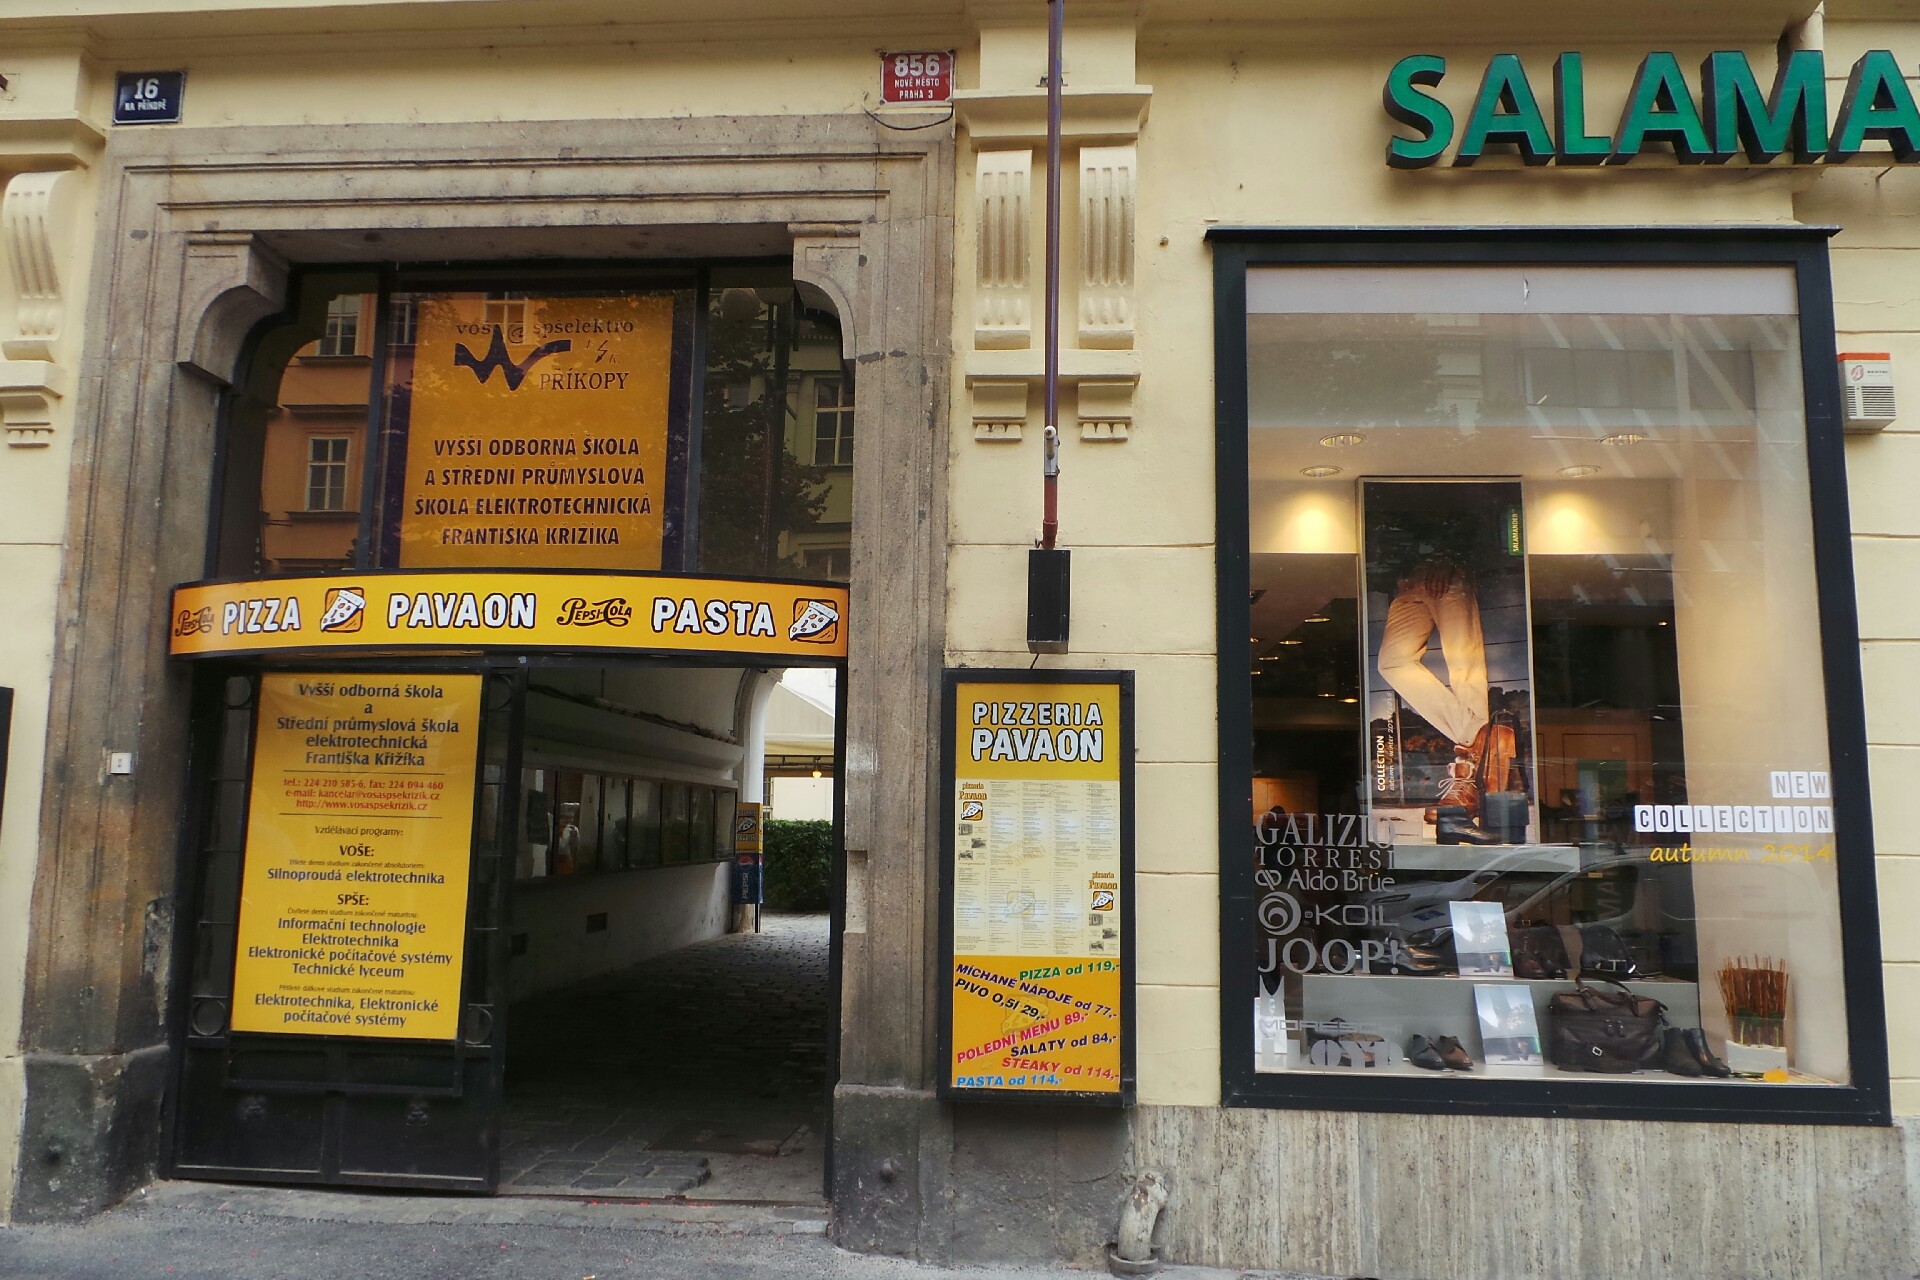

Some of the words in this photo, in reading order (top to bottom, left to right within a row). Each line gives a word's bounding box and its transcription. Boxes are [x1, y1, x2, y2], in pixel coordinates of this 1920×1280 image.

[895, 54, 940, 77] 856
[134, 78, 160, 99] 16
[895, 77, 913, 88] NOVÉ
[915, 76, 939, 87] MĚSTO
[899, 90, 924, 99] PRAHA
[928, 90, 933, 99] 3
[124, 102, 136, 110] NA
[540, 367, 630, 390] PŘÍKOPY
[434, 434, 482, 456] VYŠŠÍ
[489, 433, 576, 456] ODBORNÁ
[582, 433, 640, 455] ŠKOLA
[424, 470, 435, 486] A
[442, 464, 515, 485] STŘEDNÍ
[522, 461, 645, 485] PRŮMYSLOVÁ
[414, 494, 469, 516] ŠKOLA
[475, 493, 651, 515] ELEKTROTECHNICKÁ
[442, 522, 539, 545] FRANTIŠKA
[546, 522, 620, 545] KŘIŽÍKA
[222, 597, 301, 635] PIZZA
[387, 592, 537, 630] PAVAON
[651, 597, 777, 637] PASTA
[299, 682, 334, 699] Vyšší
[339, 683, 400, 698] odborná
[405, 684, 443, 699] škola
[364, 703, 374, 714] a
[972, 702, 1103, 726] PIZZERIA
[277, 717, 328, 731] Střední
[333, 716, 416, 733] průmyslová
[421, 718, 459, 733] škola
[306, 734, 428, 750] elektrotechnická
[971, 728, 1103, 762] PAVAON
[306, 752, 369, 766] Františka
[375, 752, 425, 767] Křižíka
[1376, 735, 1386, 791] COLLECTION
[285, 788, 316, 798] e-mail:
[305, 778, 320, 787] 224
[323, 779, 337, 788] 210
[369, 780, 386, 789] fax:
[389, 780, 404, 789] 224
[1774, 774, 1827, 795] NEW
[1638, 808, 1830, 829] COLLECTION
[360, 827, 404, 837] programy:
[1255, 811, 1396, 849] GALIZIO
[339, 843, 375, 857] VOŠE:
[1255, 846, 1395, 870] TORRESI
[1650, 843, 1750, 863] autumn
[1761, 843, 1834, 863] 2014
[267, 868, 342, 882] Silnoproudá
[346, 870, 445, 885] elektrotechnika
[1287, 870, 1339, 891] Aldo
[337, 892, 370, 906] SPŠE:
[278, 917, 346, 931] Informační
[350, 919, 426, 935] technologie
[302, 933, 399, 948] Elektrotechnika
[248, 946, 325, 960] Elektronické
[329, 949, 396, 963] počítačové
[401, 950, 453, 966] systémy
[1257, 937, 1399, 975] JOOP!
[292, 963, 355, 976] Technické
[359, 964, 405, 979] lyceum
[1019, 967, 1061, 981] PIZZA
[1066, 964, 1082, 976] od
[1087, 960, 1120, 974] 119,-
[955, 978, 989, 998] PIVO
[1021, 1005, 1046, 1021] 29,-
[956, 963, 1018, 988] MÍCHANÉ
[1020, 982, 1073, 1005] NÁPOJE
[1075, 999, 1092, 1011] od
[1094, 1004, 1117, 1019] 77,-
[255, 993, 355, 1010] Elektrotechnika,
[360, 998, 439, 1012] Elektronické
[284, 1010, 351, 1024] počítačové
[355, 1012, 407, 1028] systémy
[957, 1033, 1017, 1064] POLEDNÍ
[1021, 1018, 1060, 1042] MENU
[1064, 1011, 1088, 1026] 89,-
[1071, 1035, 1087, 1048] od
[1092, 1032, 1117, 1044] 84,-
[1002, 1057, 1061, 1072] STEAKY
[1064, 1065, 1082, 1075] od
[1087, 1066, 1120, 1079] 114,-
[957, 1075, 1004, 1087] PASTA
[1008, 1075, 1026, 1085] od
[1031, 1074, 1064, 1085] 114,-
